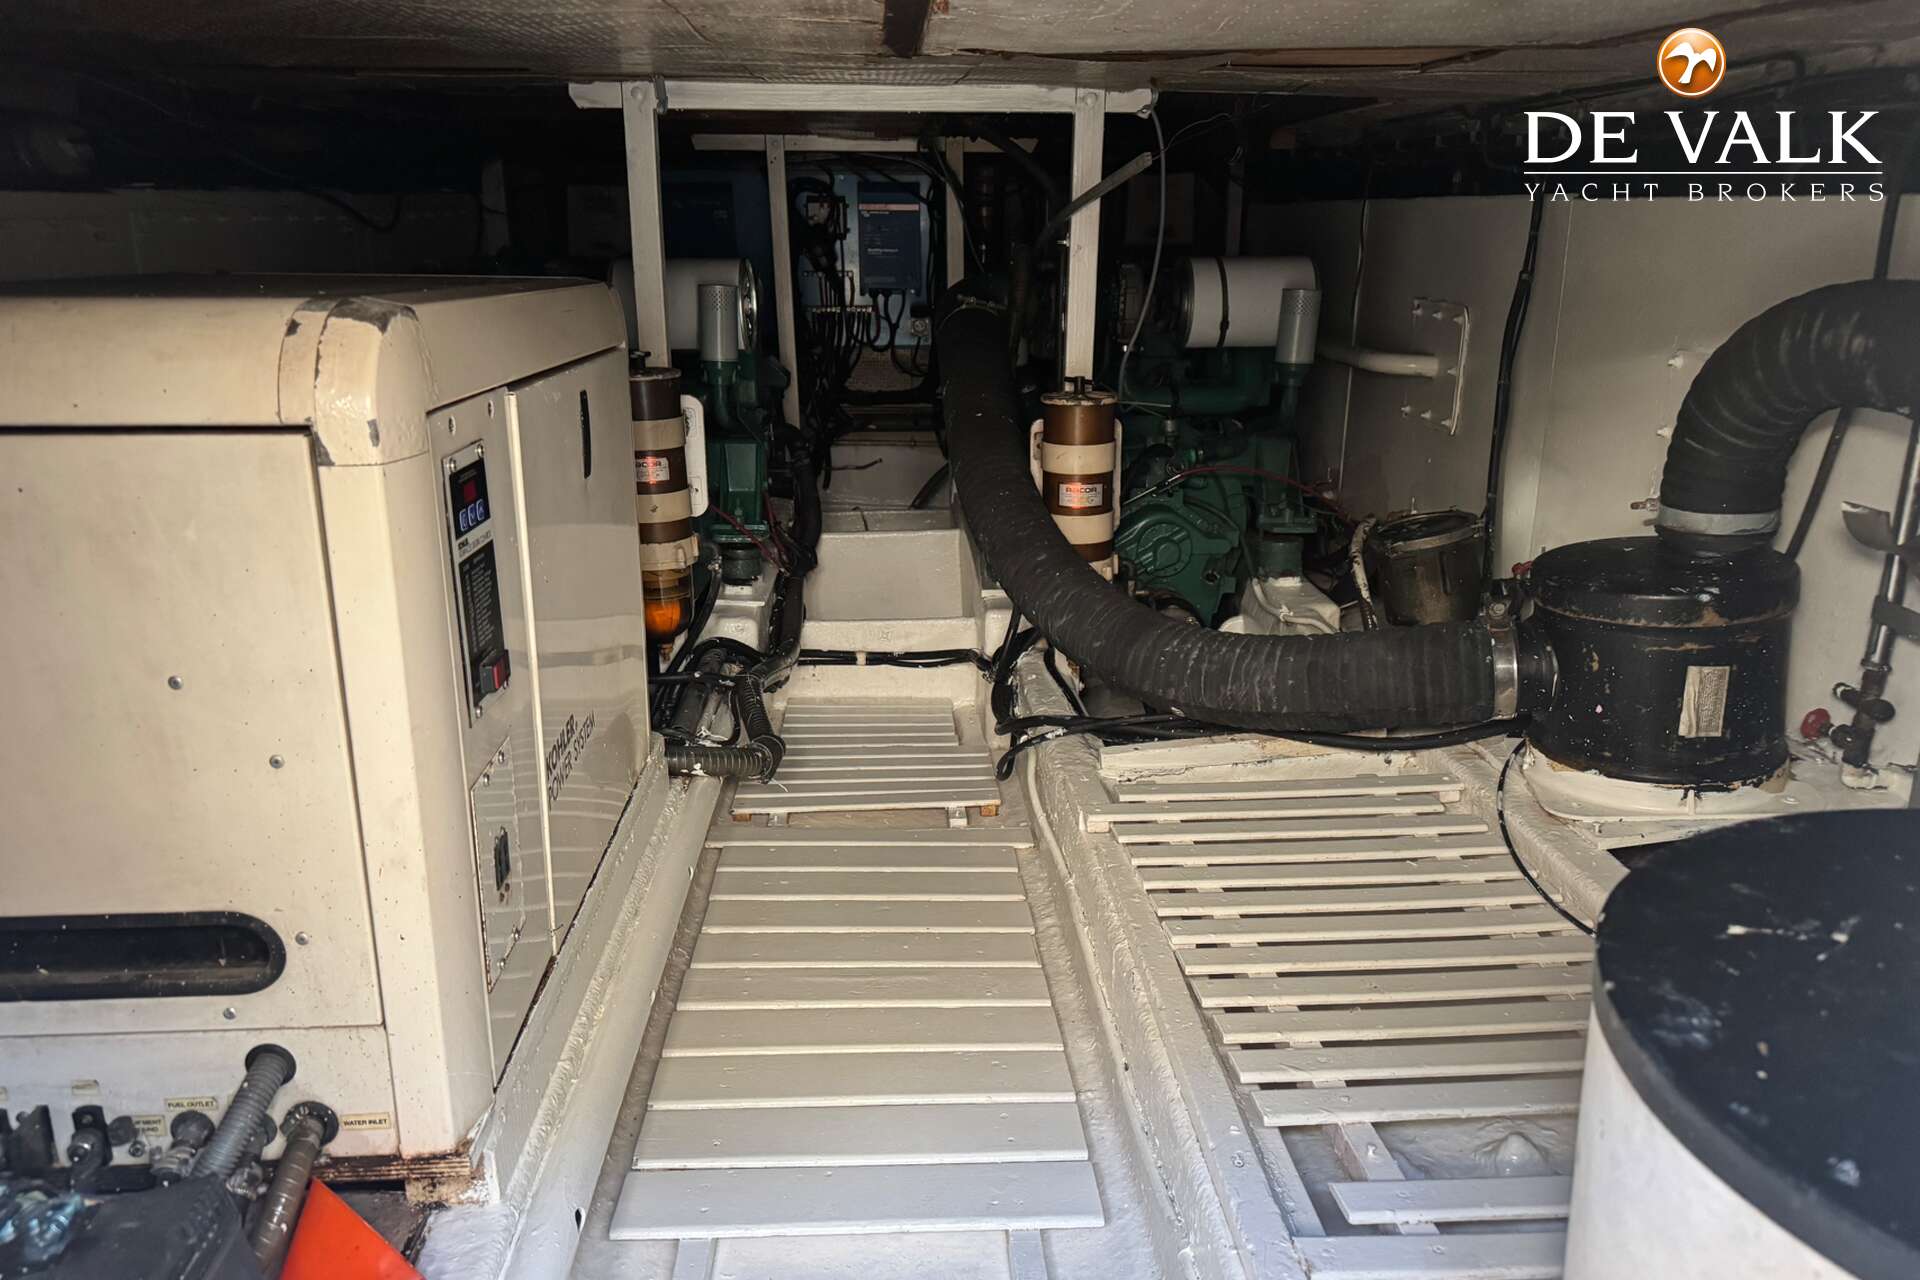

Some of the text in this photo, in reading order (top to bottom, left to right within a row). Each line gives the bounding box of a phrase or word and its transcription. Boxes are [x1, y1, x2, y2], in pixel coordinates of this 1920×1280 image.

[1065, 486, 1097, 494] RACOR
[548, 750, 573, 812] POWER
[186, 1100, 214, 1108] OUTLET
[343, 1119, 368, 1127] WATER
